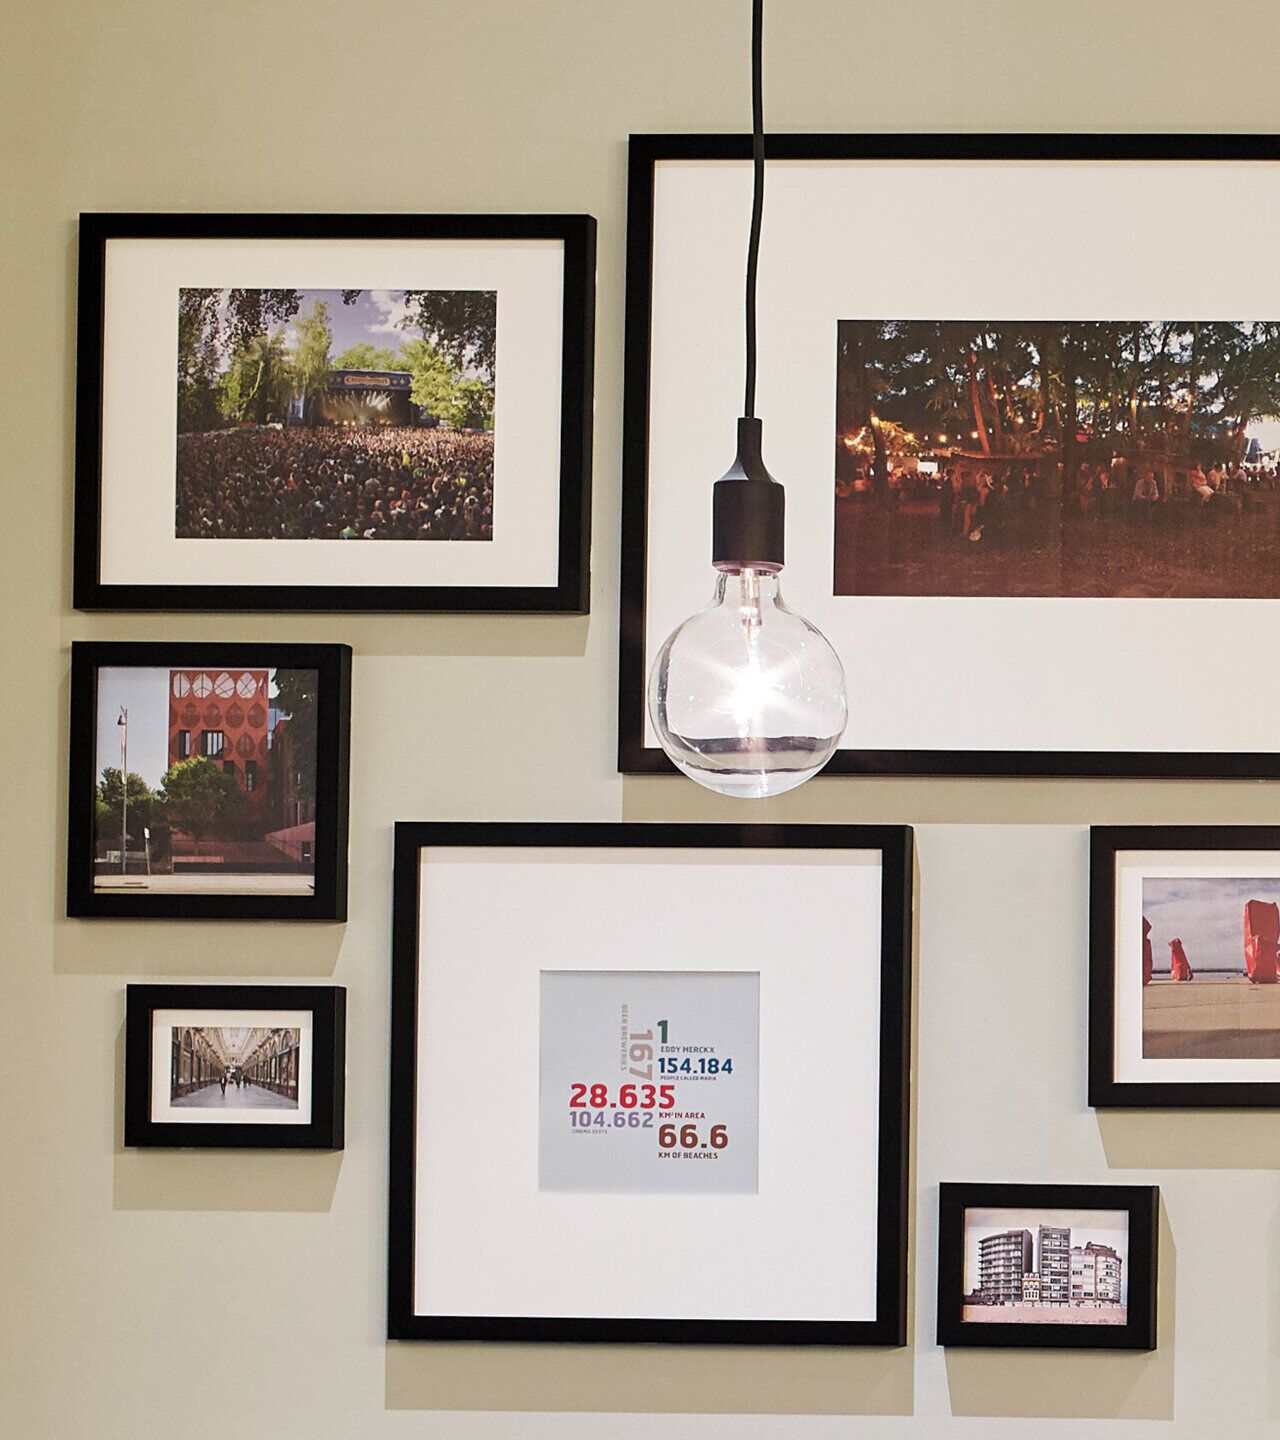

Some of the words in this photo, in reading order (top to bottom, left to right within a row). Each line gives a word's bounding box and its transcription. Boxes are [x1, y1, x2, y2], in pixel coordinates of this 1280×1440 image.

[657, 1019, 668, 1044] 1
[629, 1029, 653, 1081] 167
[660, 1045, 680, 1053] EDDY
[658, 1057, 733, 1075] 154.184
[569, 1083, 676, 1109] 28.635
[569, 1110, 654, 1128] 104.662
[684, 1112, 706, 1120] AREA
[658, 1123, 729, 1149] 66.6
[658, 1152, 671, 1160] KM
[672, 1152, 682, 1160] OF
[683, 1152, 719, 1160] BEACHES
